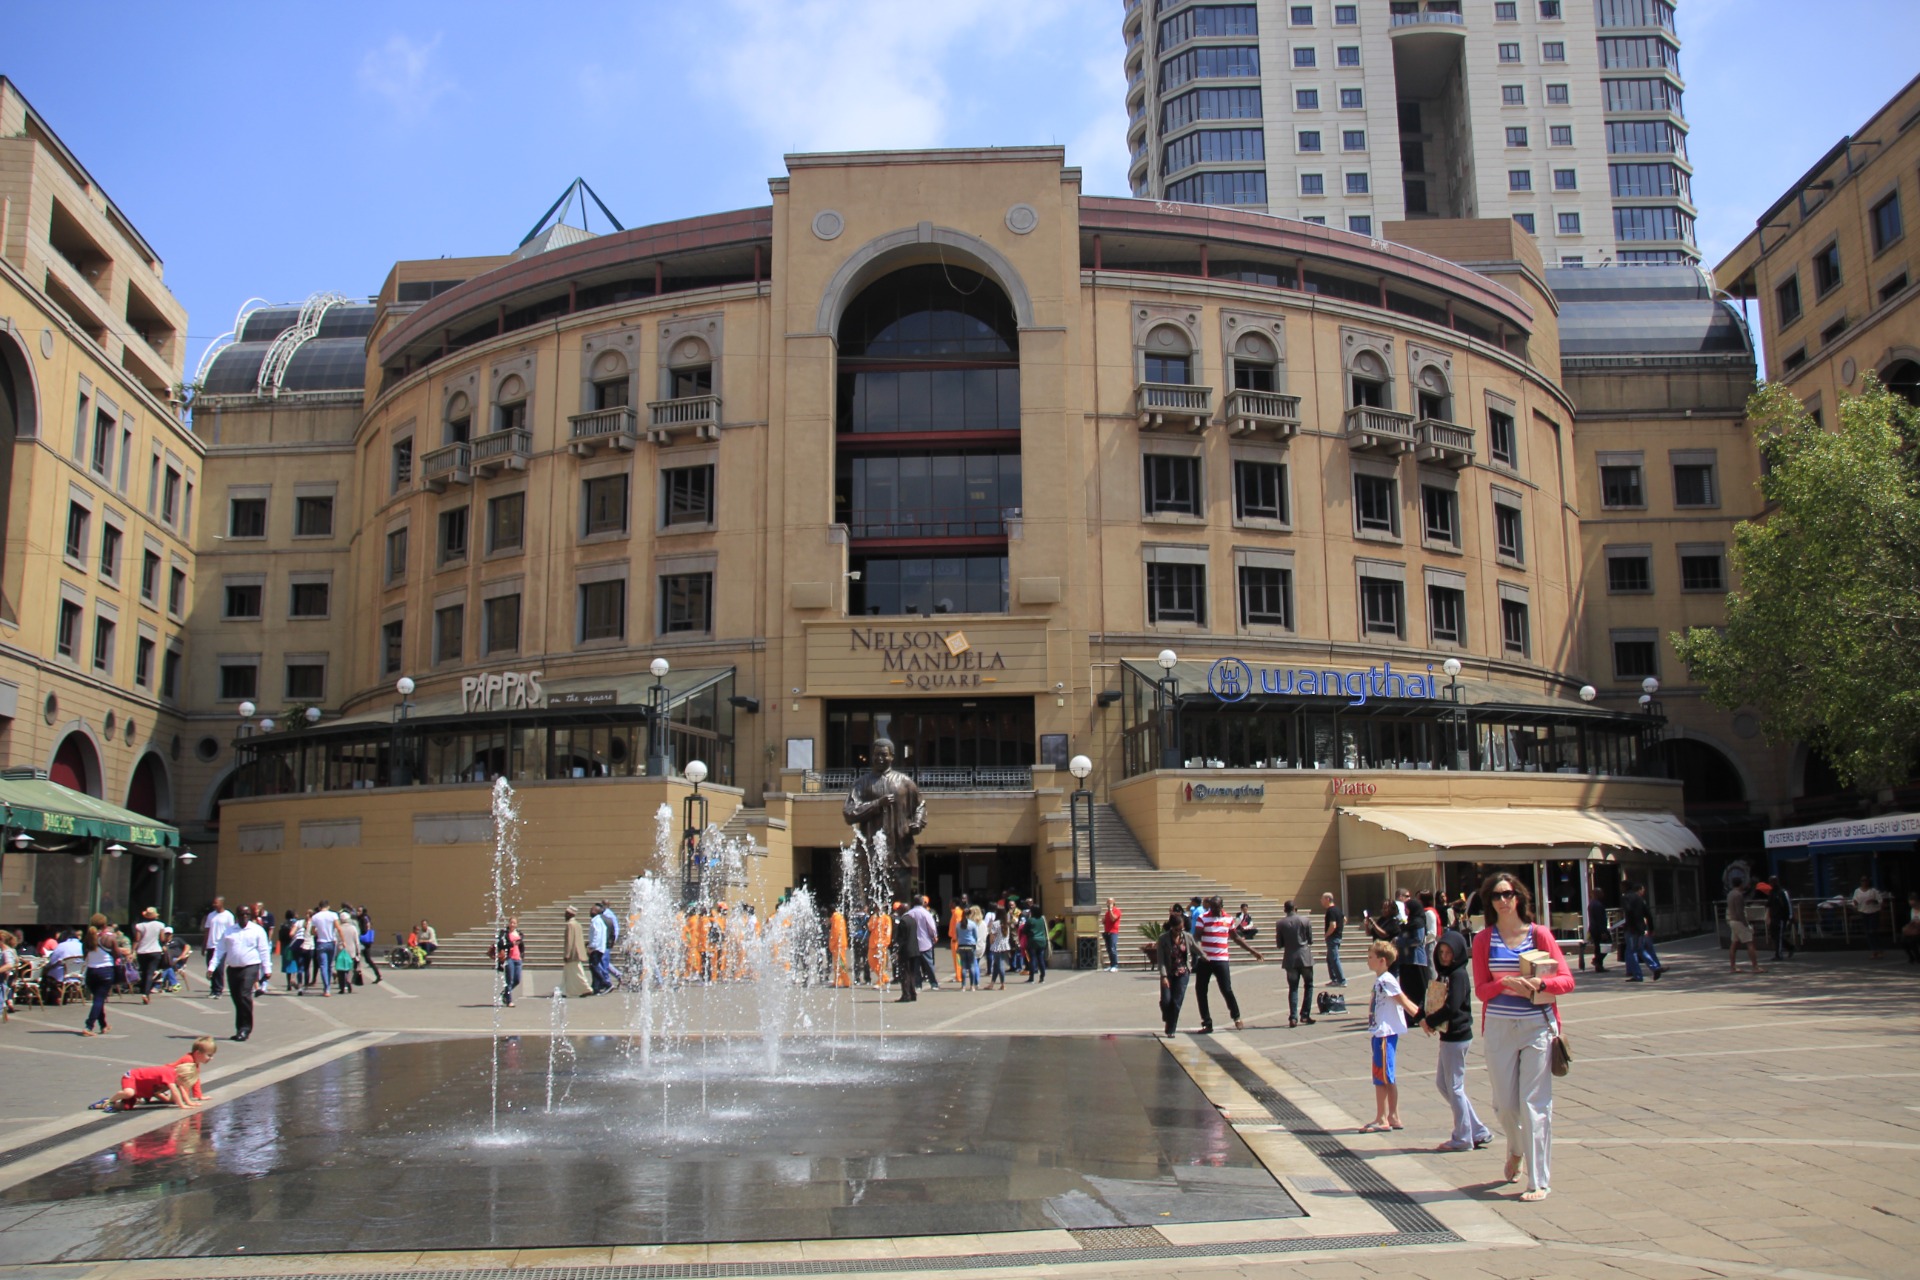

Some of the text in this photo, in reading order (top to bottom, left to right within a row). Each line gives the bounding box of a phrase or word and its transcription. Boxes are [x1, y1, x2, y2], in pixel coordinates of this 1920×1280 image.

[851, 628, 950, 650] NELSON
[882, 650, 1005, 672] MANDELA
[461, 670, 543, 712] PAPPAS
[565, 693, 580, 702] the
[583, 694, 613, 705] square
[905, 673, 982, 690] SQUARE
[1261, 662, 1436, 706] wangthai
[1331, 777, 1377, 796] Piatto
[1768, 832, 1794, 844] OYSTERS
[1801, 830, 1820, 841] SUSHI
[1828, 827, 1842, 838] FISH
[1853, 822, 1889, 836] SHELLFISH
